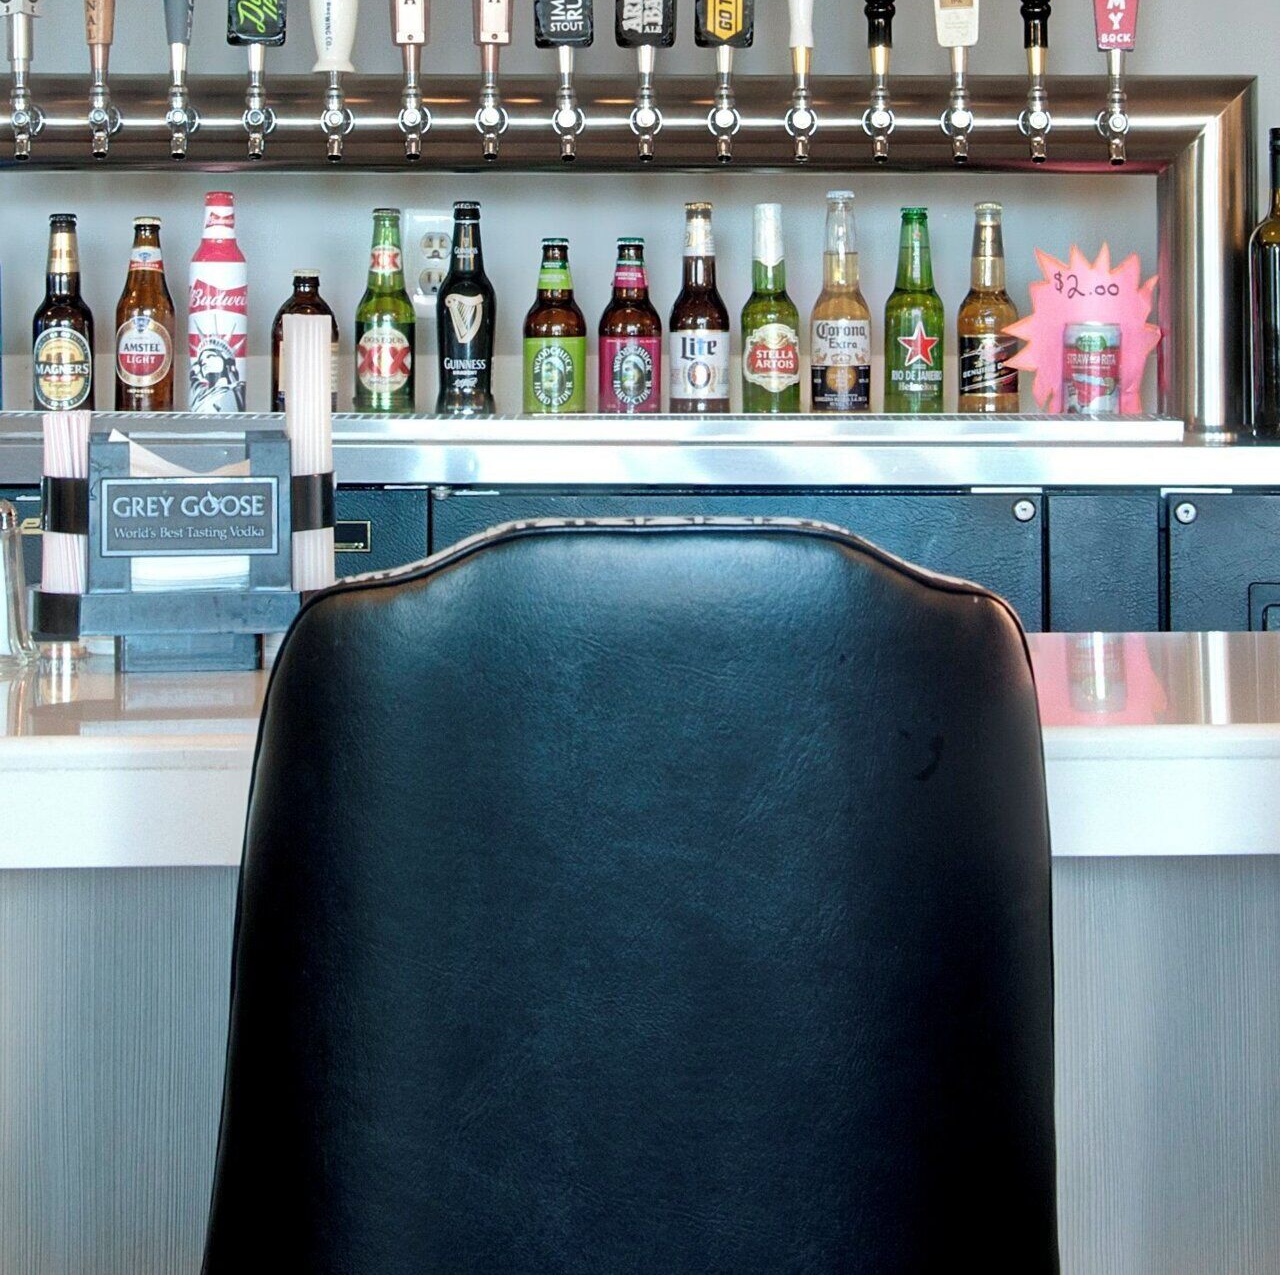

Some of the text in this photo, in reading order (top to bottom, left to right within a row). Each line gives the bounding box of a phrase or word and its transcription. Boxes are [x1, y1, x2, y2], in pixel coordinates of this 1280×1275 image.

[550, 21, 583, 31] STOUT
[719, 10, 732, 31] GO
[644, 25, 662, 33] ALE
[1101, 34, 1132, 43] BOCK
[1054, 271, 1120, 299] $2.00
[816, 322, 867, 340] Corona
[363, 336, 404, 344] DOS EQUIS
[829, 338, 857, 349] Extra
[123, 343, 160, 352] AMSTEL
[681, 336, 717, 361] Lite
[126, 355, 156, 364] LIGHT
[534, 345, 573, 374] WOODCHUCK
[613, 344, 653, 373] WOODCHUCK
[756, 350, 794, 359] STELLA
[35, 364, 89, 375] MAGNERS
[444, 357, 486, 370] GUINNESS
[755, 360, 794, 369] ARTOIS
[892, 370, 903, 380] RIO
[906, 370, 916, 380] DE
[534, 382, 573, 406] HARD CIDER
[613, 380, 653, 405] HARD CIDER
[113, 493, 266, 518] GREY GOOSE
[114, 526, 265, 540] World's Best Tasting Vodka
